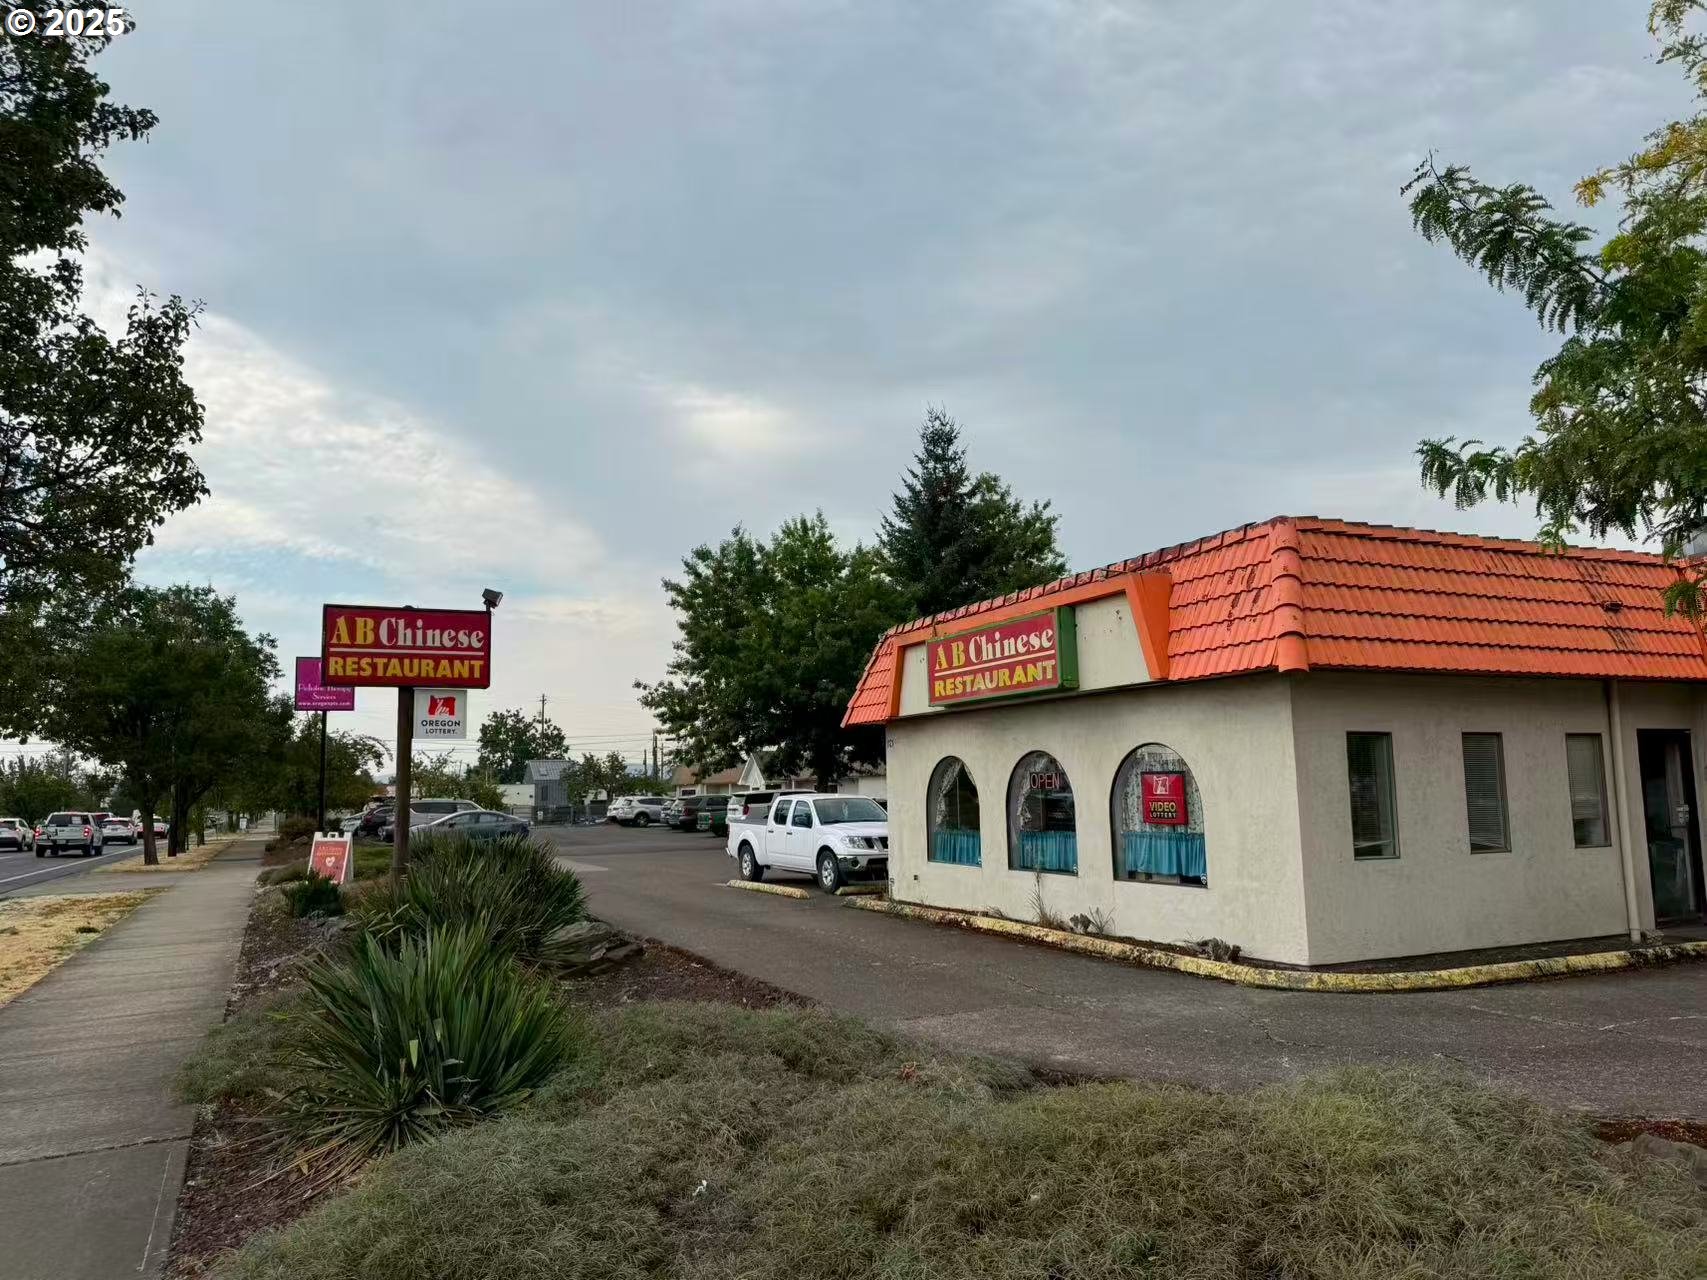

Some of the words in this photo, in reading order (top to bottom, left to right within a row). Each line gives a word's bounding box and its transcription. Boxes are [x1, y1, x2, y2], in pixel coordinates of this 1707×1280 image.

[379, 617, 484, 649] Chinese
[968, 628, 1054, 664] Chinese
[328, 656, 485, 679] RESTAURANT
[934, 659, 1056, 698] RESTAURANT
[421, 719, 461, 727] OREGON
[1030, 773, 1060, 789] OPEN
[1148, 801, 1177, 812] VIDEO
[1149, 811, 1177, 819] LOTTERY
